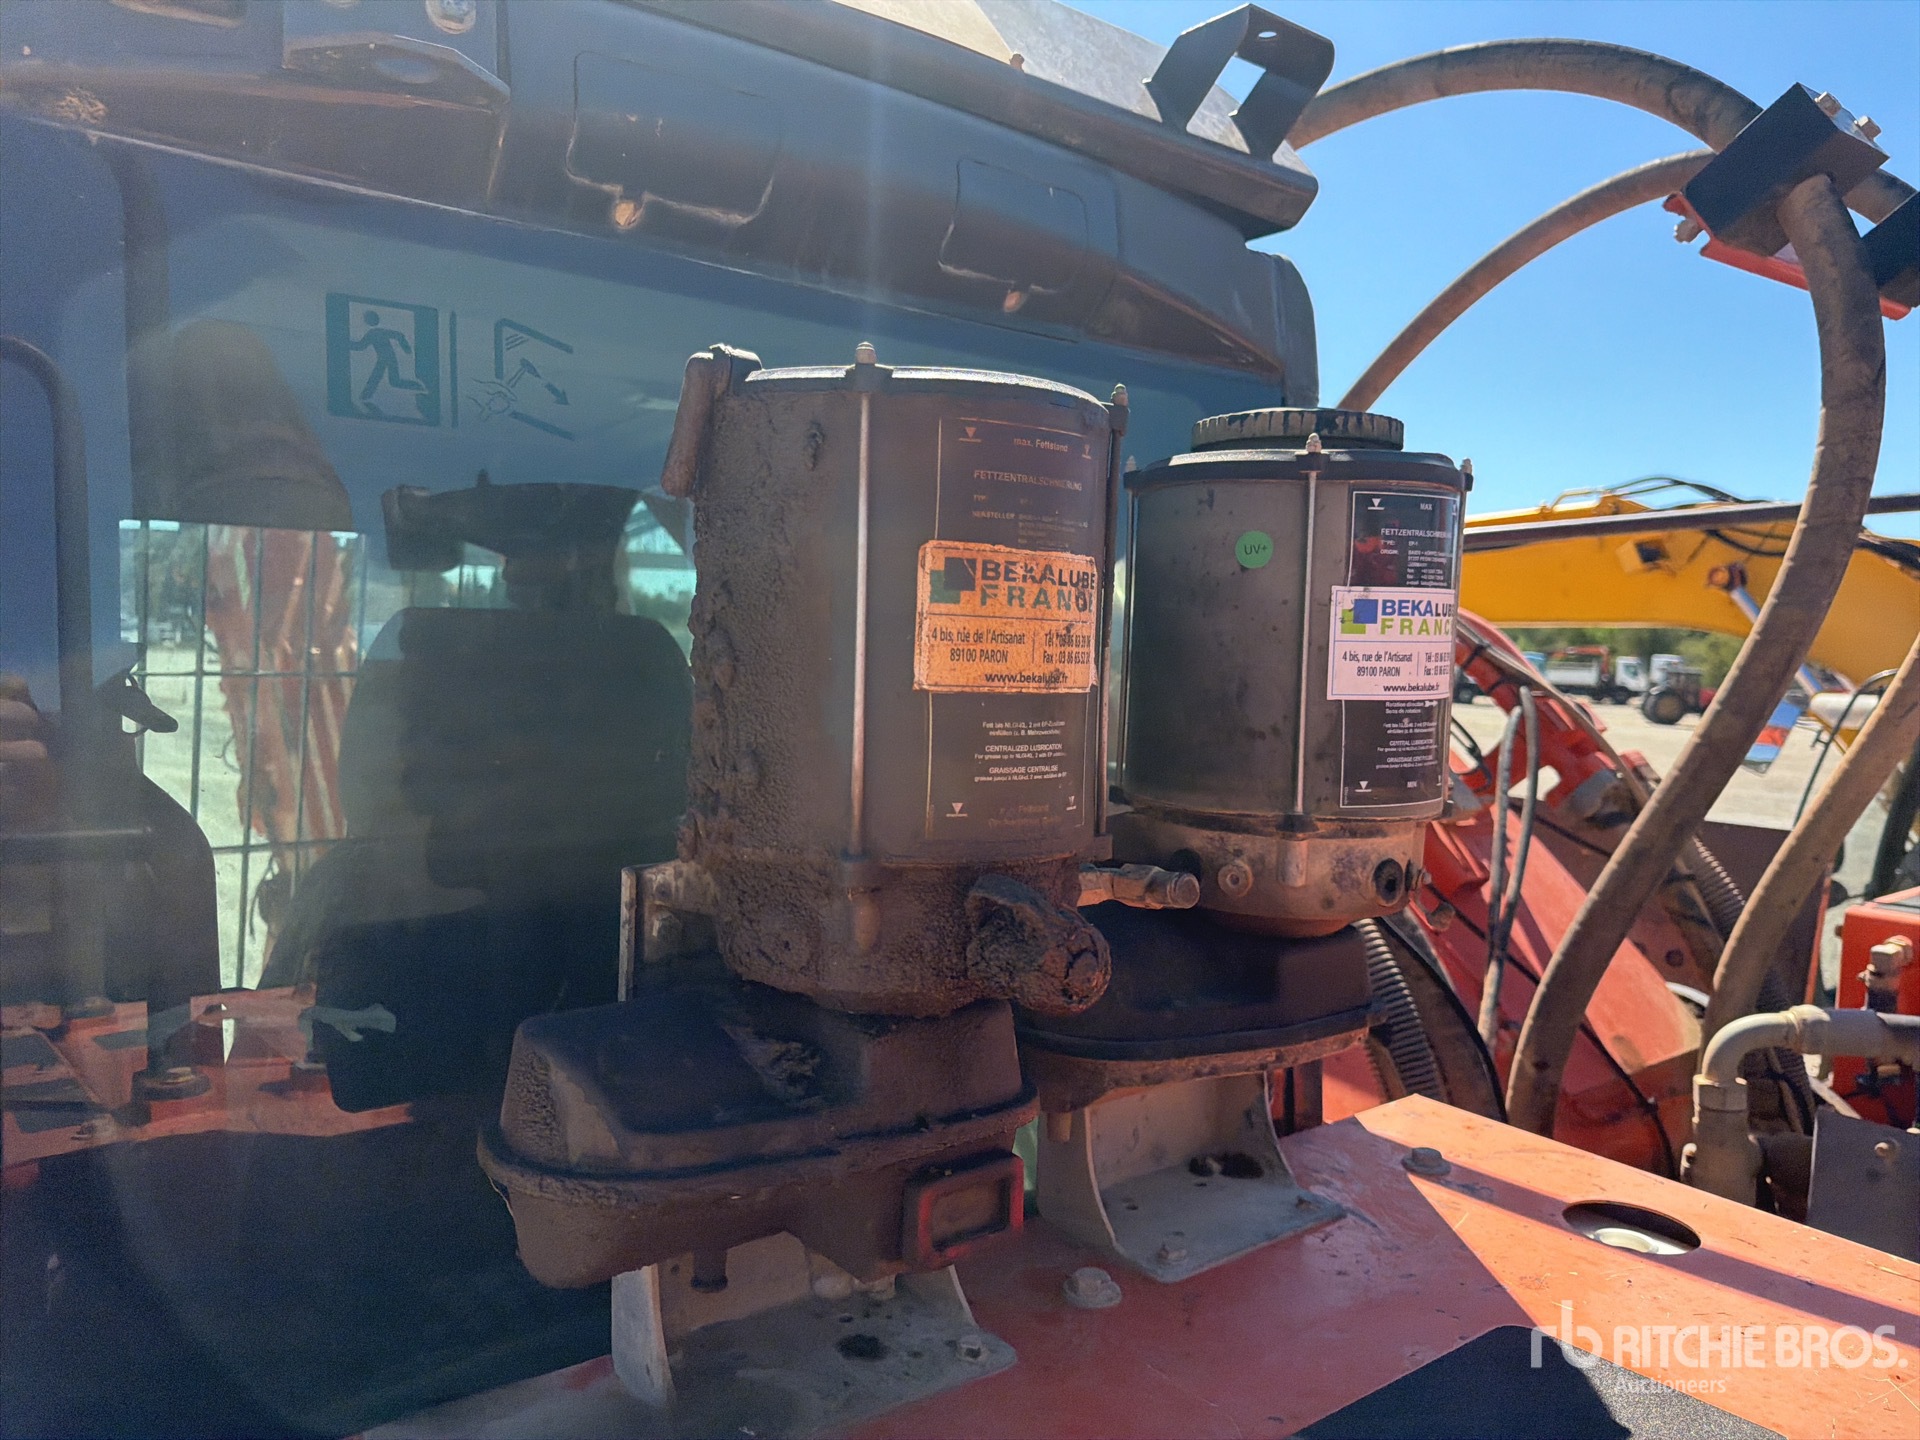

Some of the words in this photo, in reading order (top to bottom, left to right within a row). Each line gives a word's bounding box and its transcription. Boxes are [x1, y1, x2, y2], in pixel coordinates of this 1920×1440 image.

[1420, 503, 1433, 511] MAX
[1244, 544, 1268, 555] UV+
[981, 559, 1095, 590] BEKALUBE
[931, 626, 938, 641] 4
[957, 631, 970, 643] rue
[973, 629, 984, 643] de
[949, 648, 977, 662] 89100
[979, 649, 1008, 663] PARON
[1342, 651, 1348, 662] 4
[1362, 653, 1373, 662] rue
[1373, 651, 1382, 662] de
[1356, 666, 1377, 677] 89100
[1379, 666, 1401, 677] PARON
[1383, 682, 1440, 692] www.bekalube.fr
[985, 744, 1029, 752] CENTRALIZED
[988, 766, 1026, 774] GRAISSAGE
